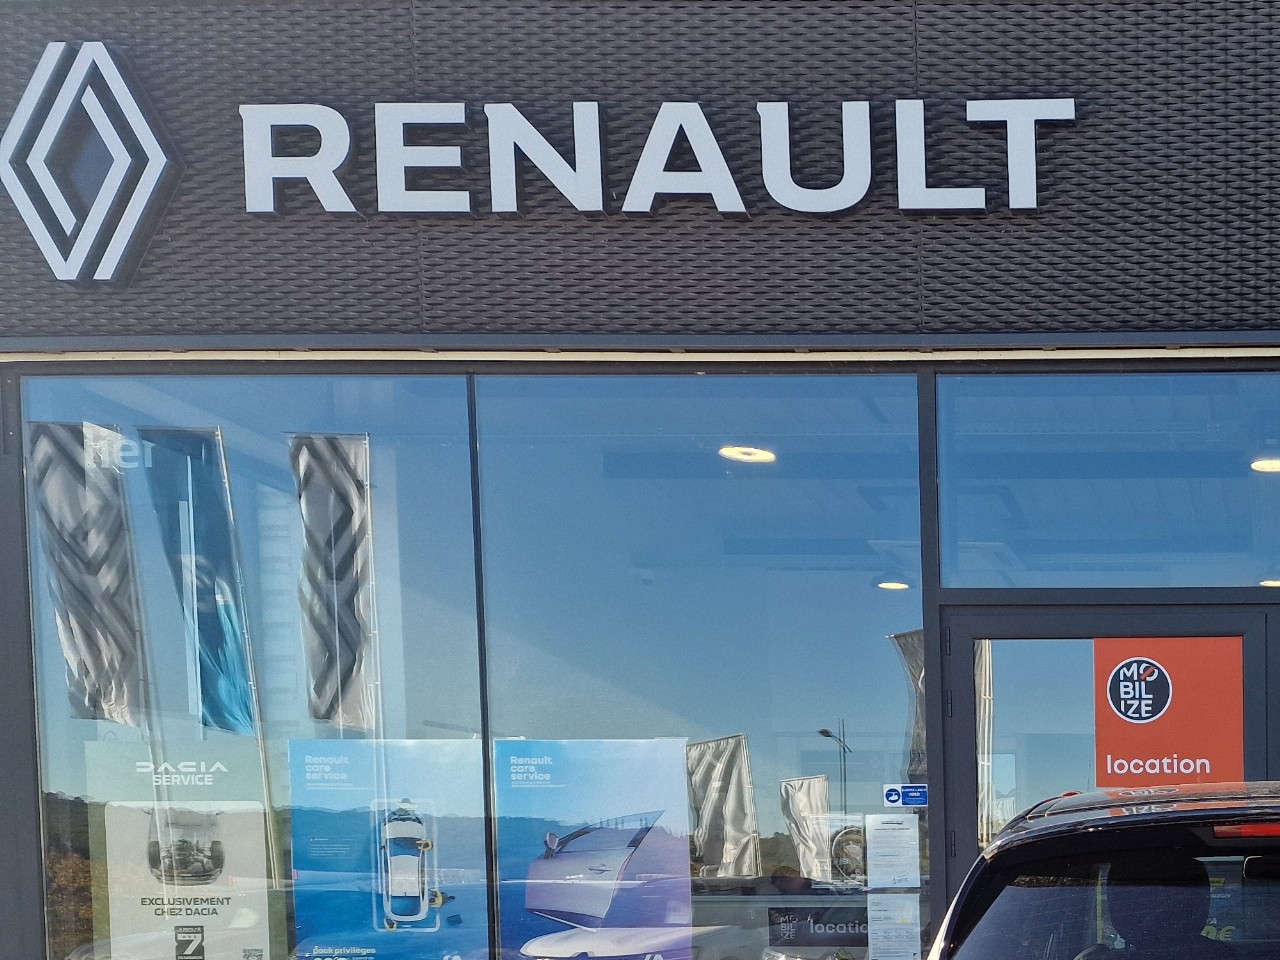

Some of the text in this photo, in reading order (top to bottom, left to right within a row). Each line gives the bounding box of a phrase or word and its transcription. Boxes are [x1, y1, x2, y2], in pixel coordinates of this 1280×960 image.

[239, 97, 1076, 214] RENAULT
[510, 756, 552, 765] Renault
[1107, 754, 1210, 774] location
[136, 762, 228, 772] DACIA
[153, 775, 213, 785] SERVICE
[511, 771, 551, 780] service
[141, 898, 231, 906] EXCLUSIVEMENT
[155, 908, 218, 916] CHEZ DACIA
